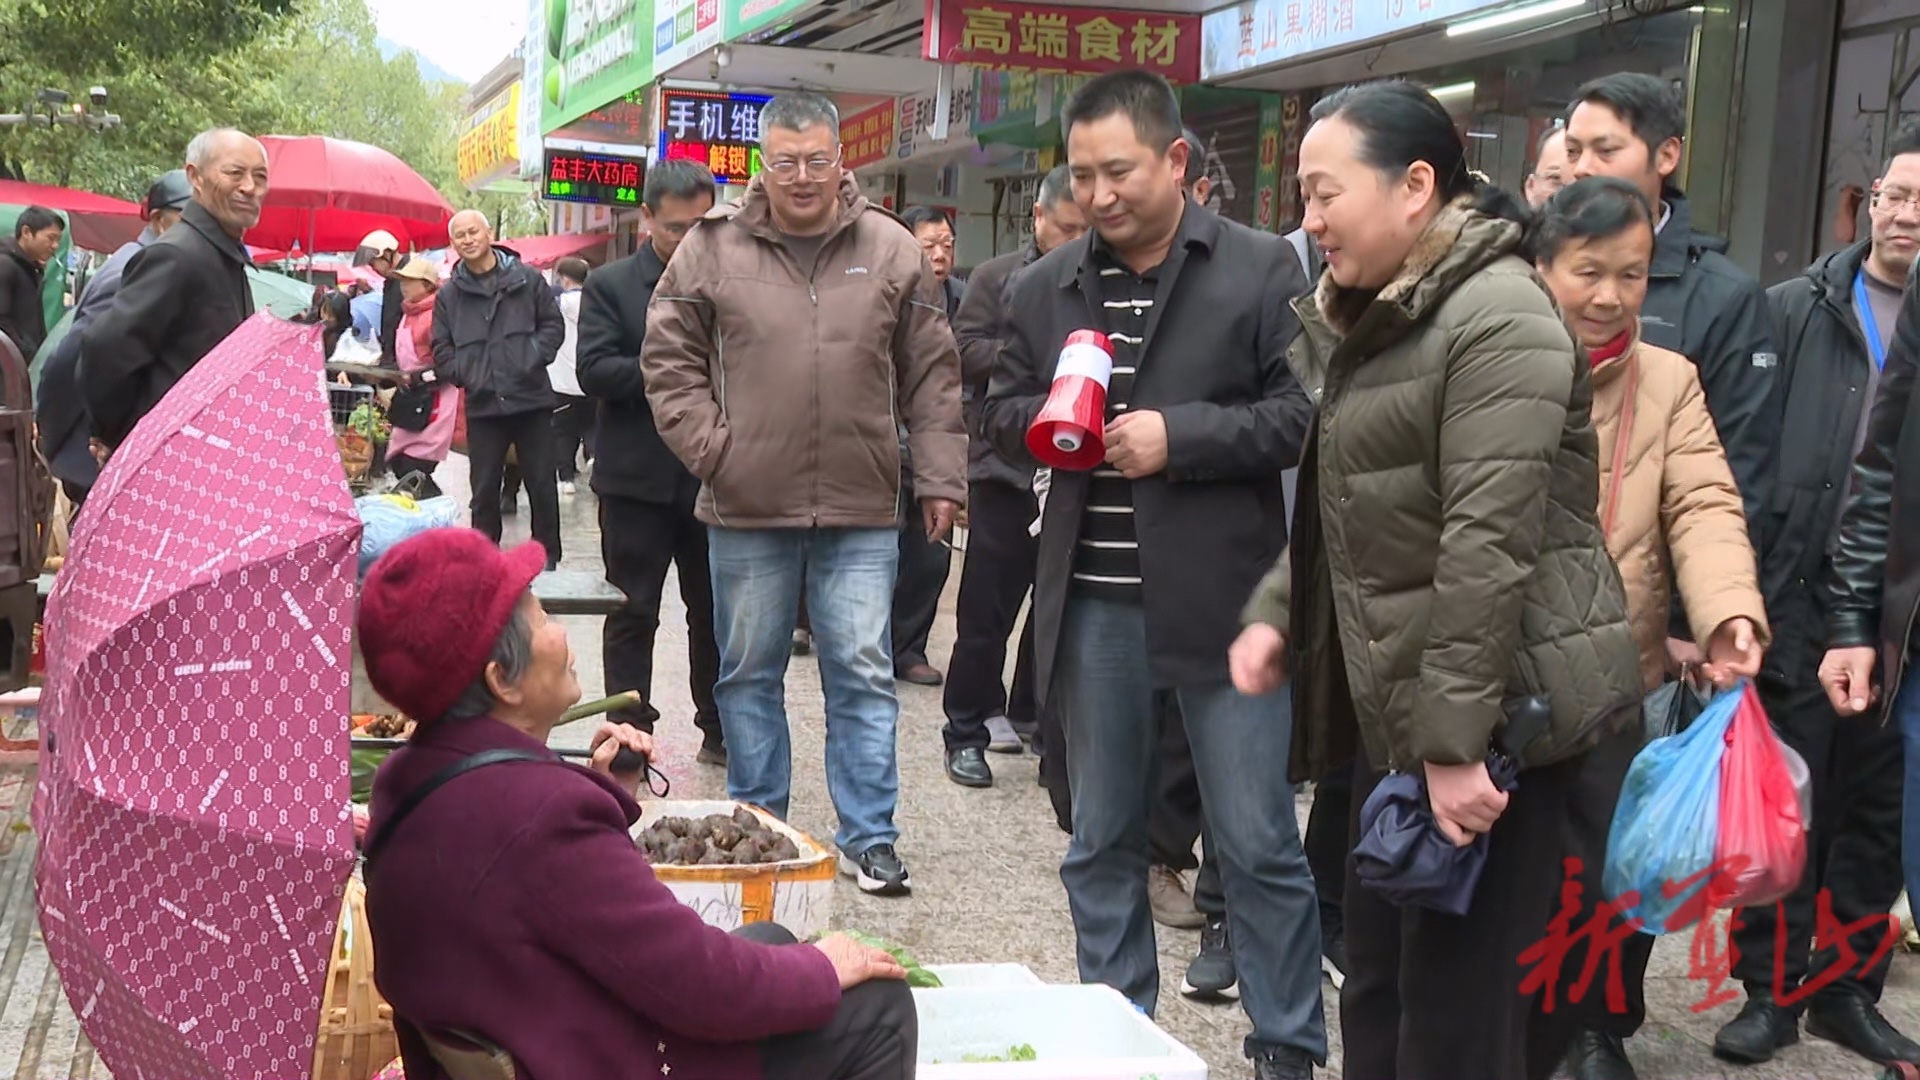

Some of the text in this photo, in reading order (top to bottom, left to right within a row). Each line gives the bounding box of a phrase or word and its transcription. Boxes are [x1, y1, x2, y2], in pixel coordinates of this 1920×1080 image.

[961, 6, 1181, 66] 高端食材
[551, 156, 639, 187] 益丰大药房
[708, 143, 747, 175] 解锁
[174, 663, 204, 677] man
[158, 896, 187, 920] man
[265, 893, 310, 985] super man
